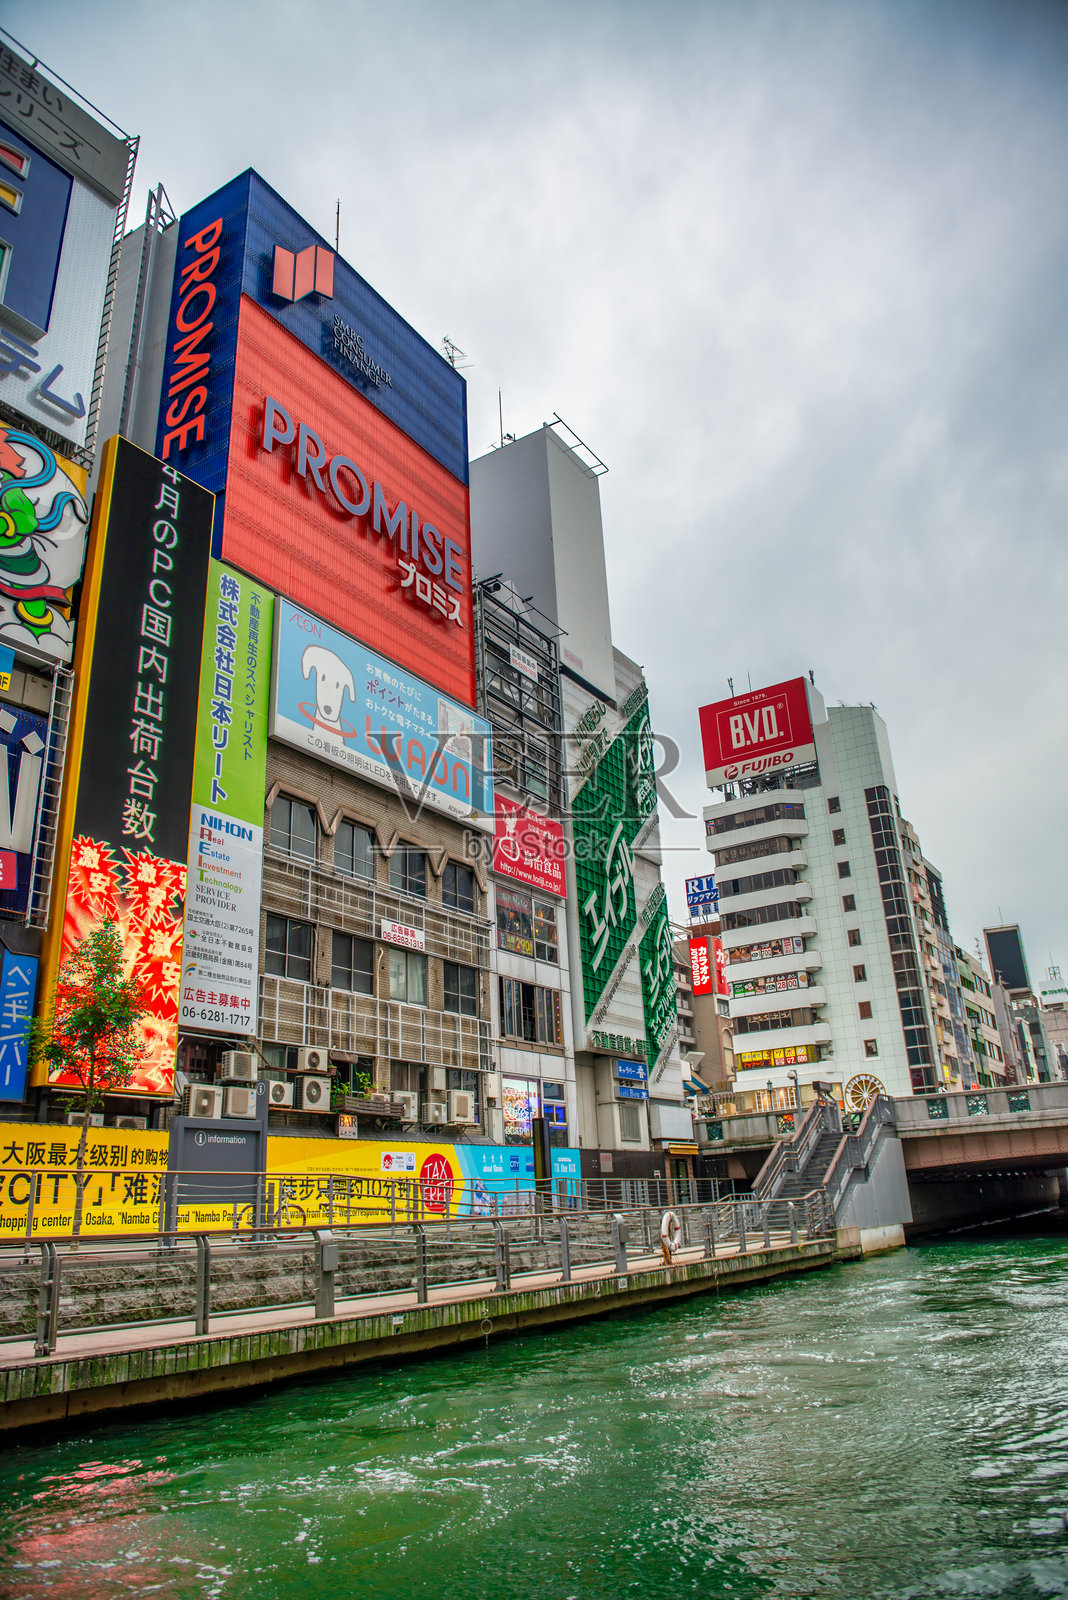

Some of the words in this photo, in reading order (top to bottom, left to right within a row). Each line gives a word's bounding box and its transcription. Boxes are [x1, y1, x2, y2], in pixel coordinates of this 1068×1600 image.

[162, 217, 223, 461] PROMISE
[334, 314, 364, 349] SMBC
[334, 326, 392, 388] CONSUMER
[334, 338, 381, 388] FINANCE
[262, 396, 464, 594] PROMISE
[398, 558, 464, 629] プロミス
[210, 573, 241, 804] 株式会社日本リート
[244, 590, 261, 761] 不動産再生のスペシャリスト
[366, 663, 422, 702] お買物のたびに
[733, 698, 750, 706] Since
[729, 705, 784, 749] B.V.D.
[741, 752, 794, 775] FUJIBO
[200, 813, 253, 842] NIHON
[200, 827, 224, 846] Real
[199, 841, 231, 861] Estate
[196, 867, 243, 894] Technology
[198, 854, 242, 879] Investment
[195, 884, 231, 901] SERVICE
[195, 893, 237, 912] PROVIDER
[583, 820, 636, 973] エイブル
[690, 948, 701, 986] JOYSOUND
[698, 946, 710, 985] カラオケ
[183, 987, 251, 1011] 広告主募集中
[182, 1005, 251, 1027] 06-6281-1717
[339, 1116, 357, 1128] BAR
[207, 1135, 247, 1145] information
[424, 1159, 448, 1185] TAX
[42, 1214, 72, 1227] center
[85, 1212, 115, 1227] Osaka,
[118, 1211, 150, 1225] "Namba
